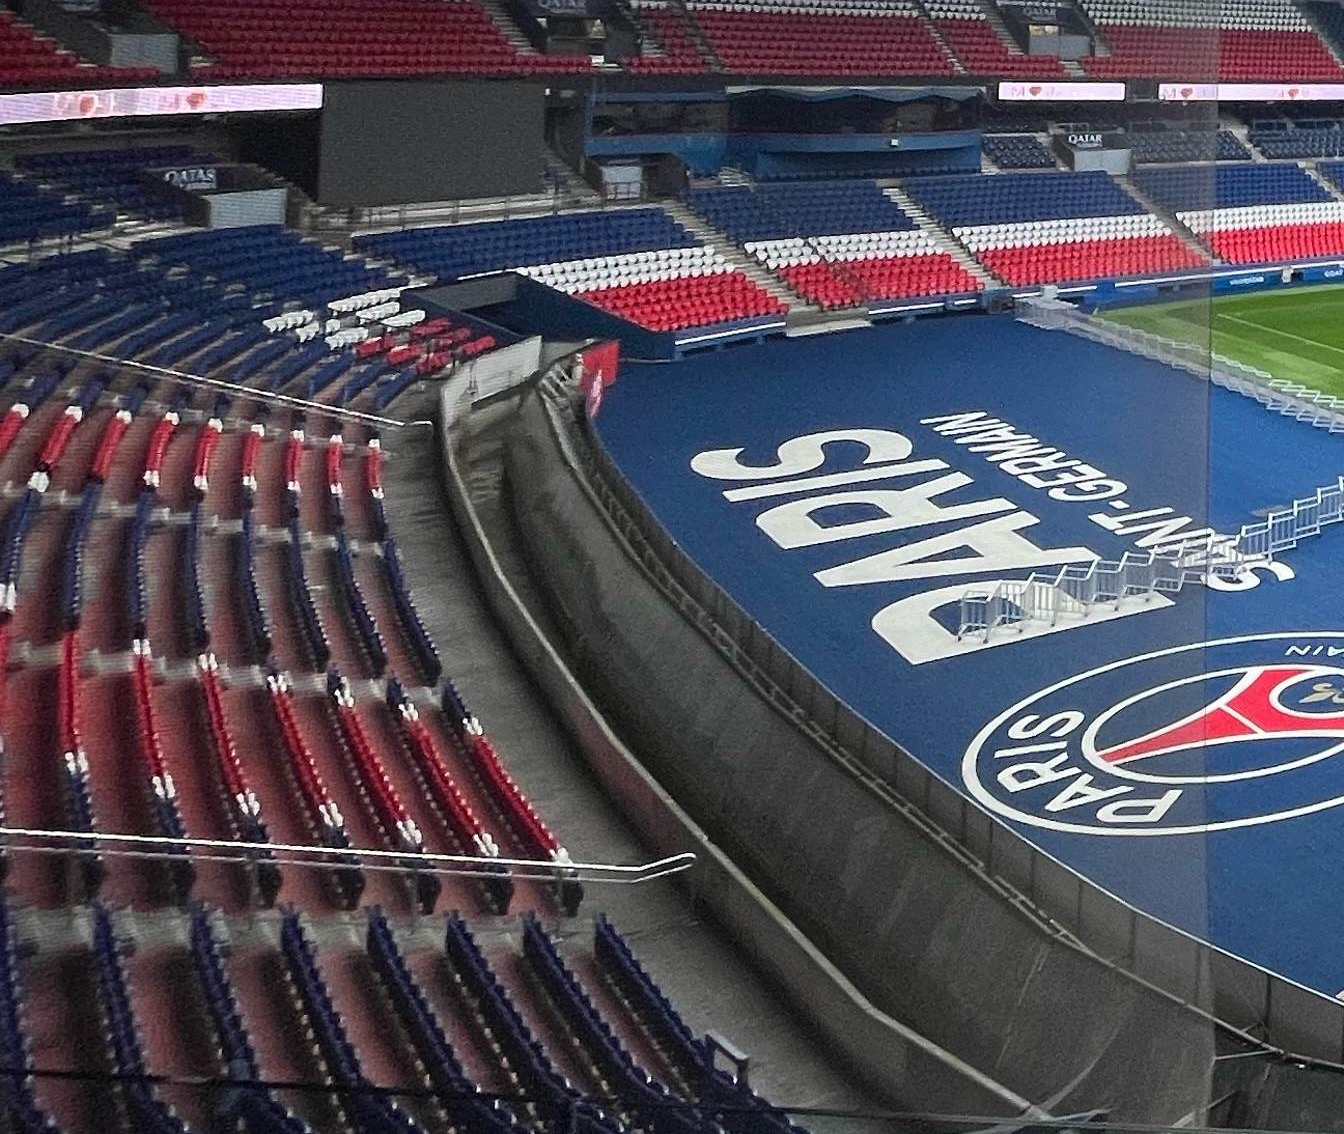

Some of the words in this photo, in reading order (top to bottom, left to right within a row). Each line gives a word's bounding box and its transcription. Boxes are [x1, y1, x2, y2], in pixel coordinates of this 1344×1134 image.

[1068, 133, 1103, 145] QATAR
[690, 428, 1175, 665] PARIS
[993, 710, 1183, 823] PARIS
